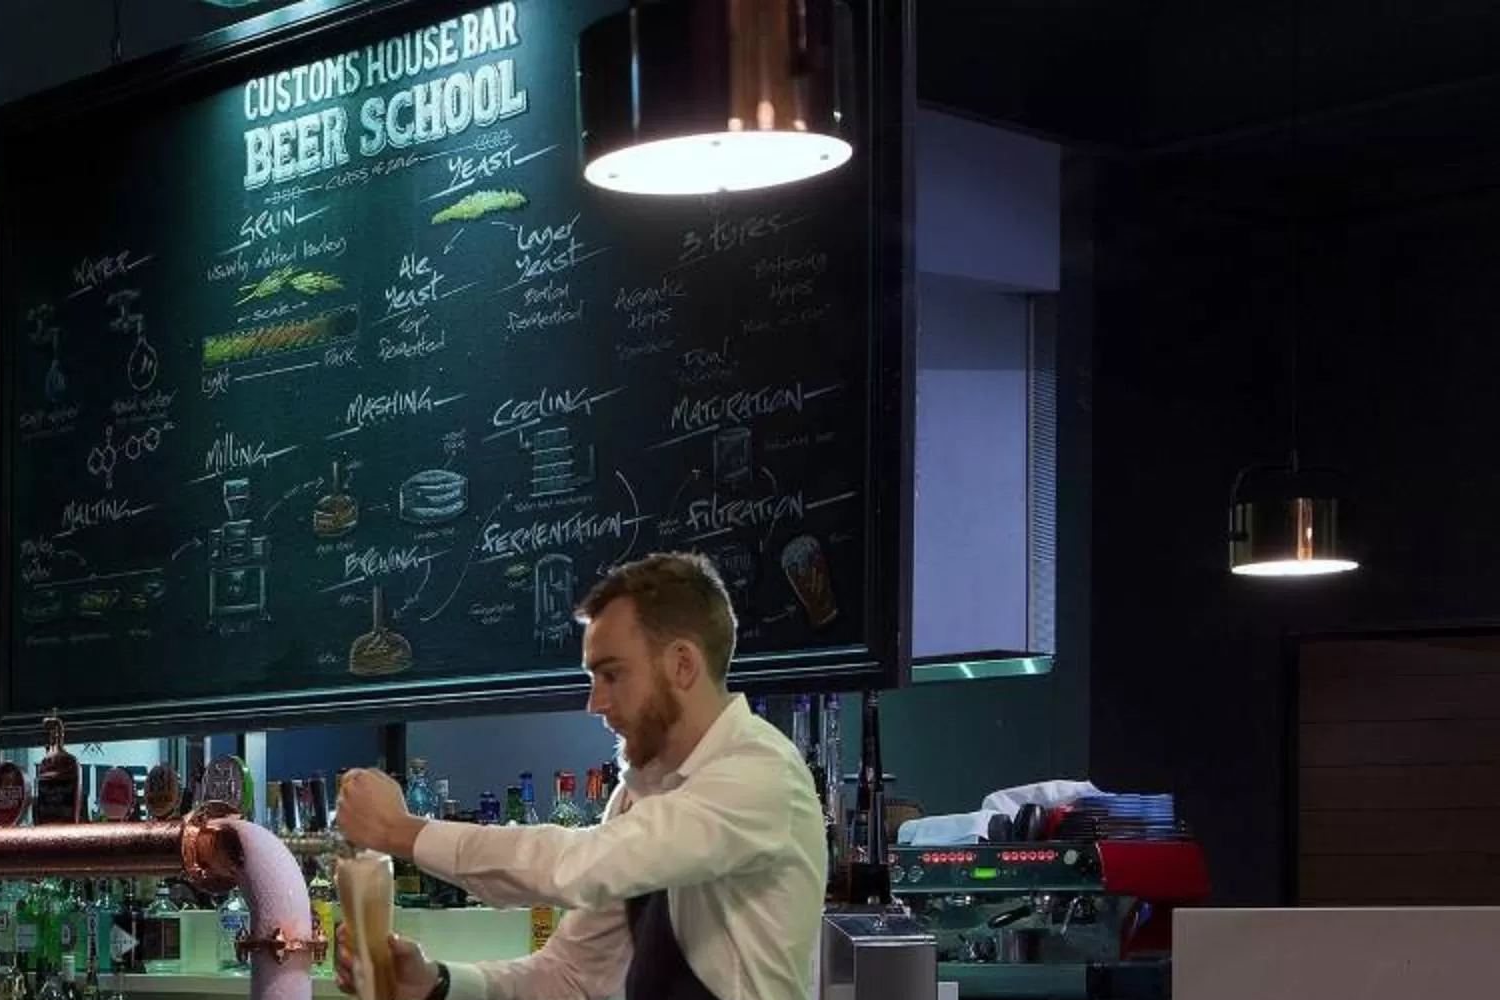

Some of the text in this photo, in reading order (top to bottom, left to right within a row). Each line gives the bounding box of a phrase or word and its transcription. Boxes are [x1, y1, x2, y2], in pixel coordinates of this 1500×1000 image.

[243, 1, 521, 120] CUSTOMS HOUSE BAR
[243, 59, 529, 191] BEER SCHOOL
[449, 143, 518, 187] YEAST
[516, 211, 582, 257] Lager
[345, 385, 433, 424] MASHING
[669, 381, 804, 431] MATURATION
[61, 497, 130, 529] MALTING
